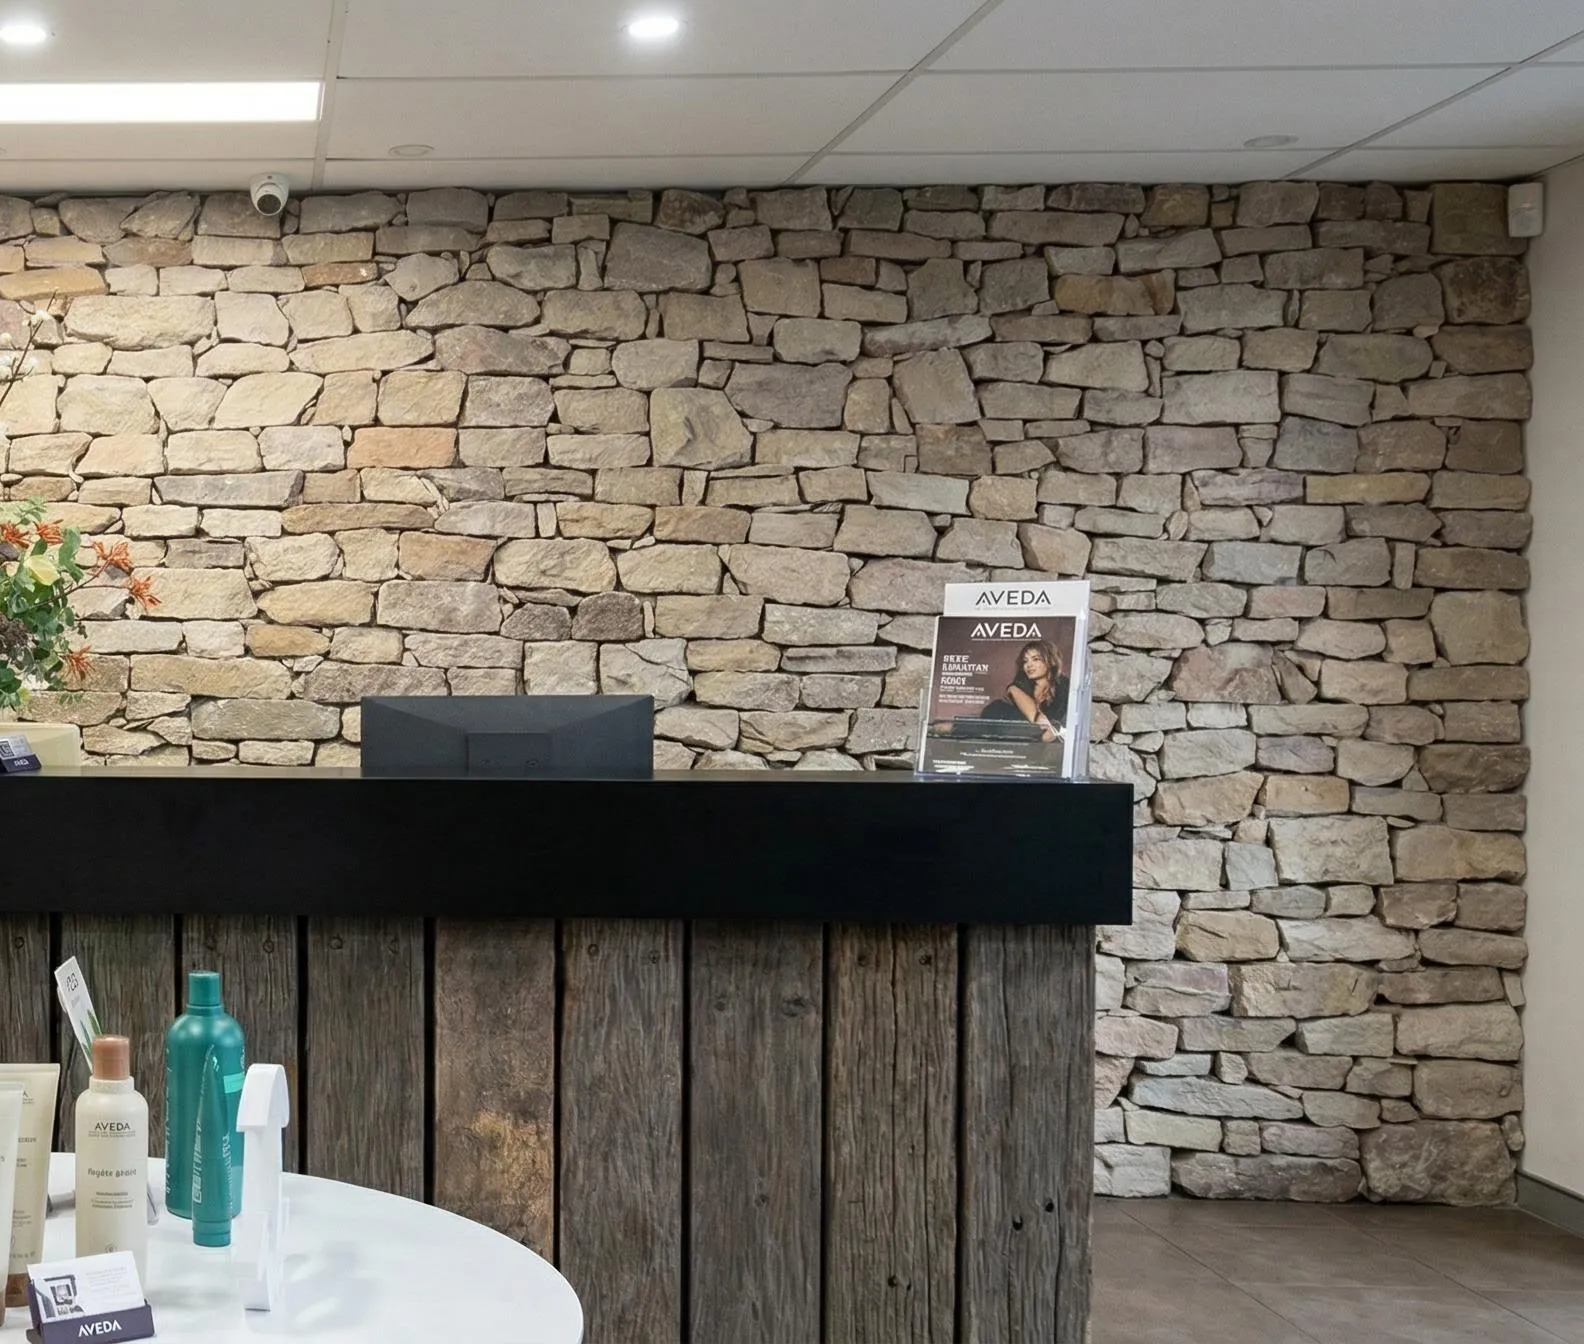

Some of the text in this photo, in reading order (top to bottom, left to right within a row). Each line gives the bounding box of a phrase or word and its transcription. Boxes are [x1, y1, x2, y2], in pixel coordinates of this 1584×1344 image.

[976, 590, 1051, 606] AVEDA
[971, 622, 1042, 638] AVEDA
[94, 1122, 130, 1132] AVEDA
[78, 1320, 122, 1337] AVEDA
